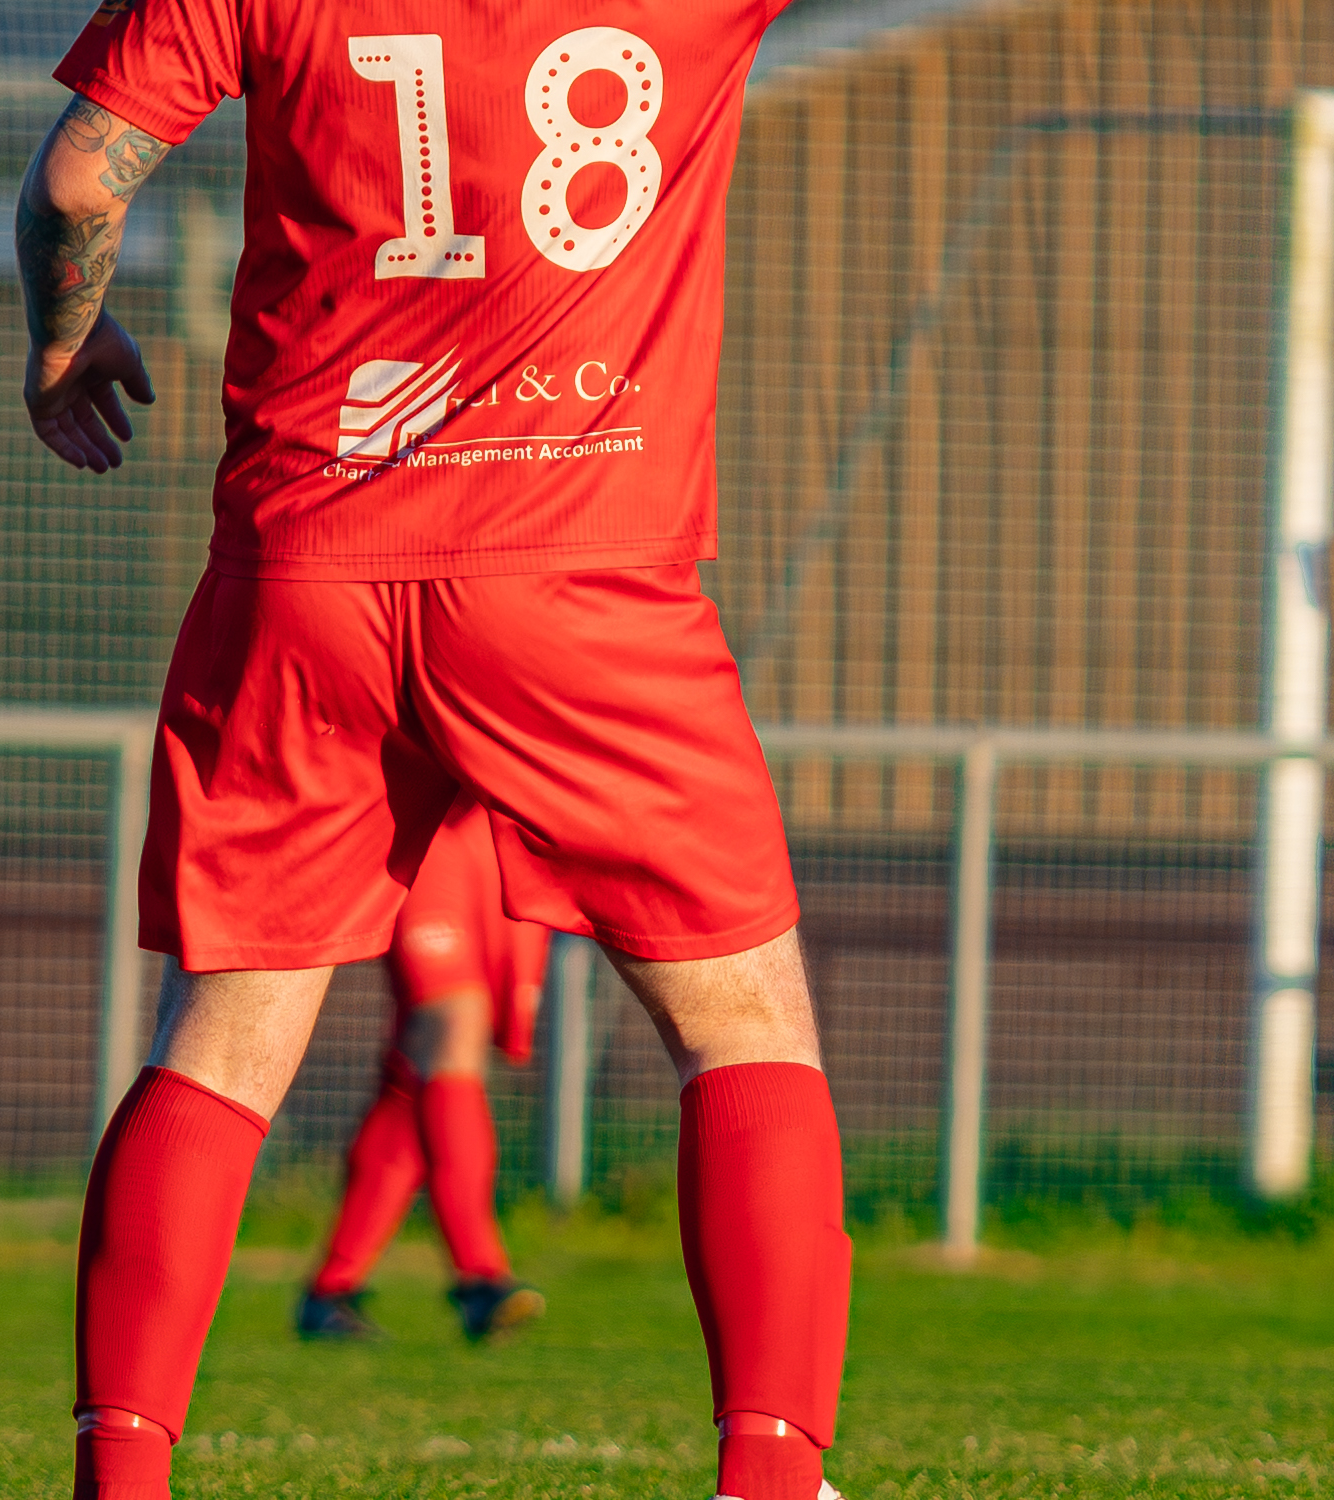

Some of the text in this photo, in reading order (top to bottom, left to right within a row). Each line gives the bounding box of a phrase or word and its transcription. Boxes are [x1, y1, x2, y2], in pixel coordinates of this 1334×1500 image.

[348, 26, 664, 280] 18
[515, 360, 642, 402] & Co.
[406, 444, 534, 468] Management
[538, 435, 644, 460] Accountant
